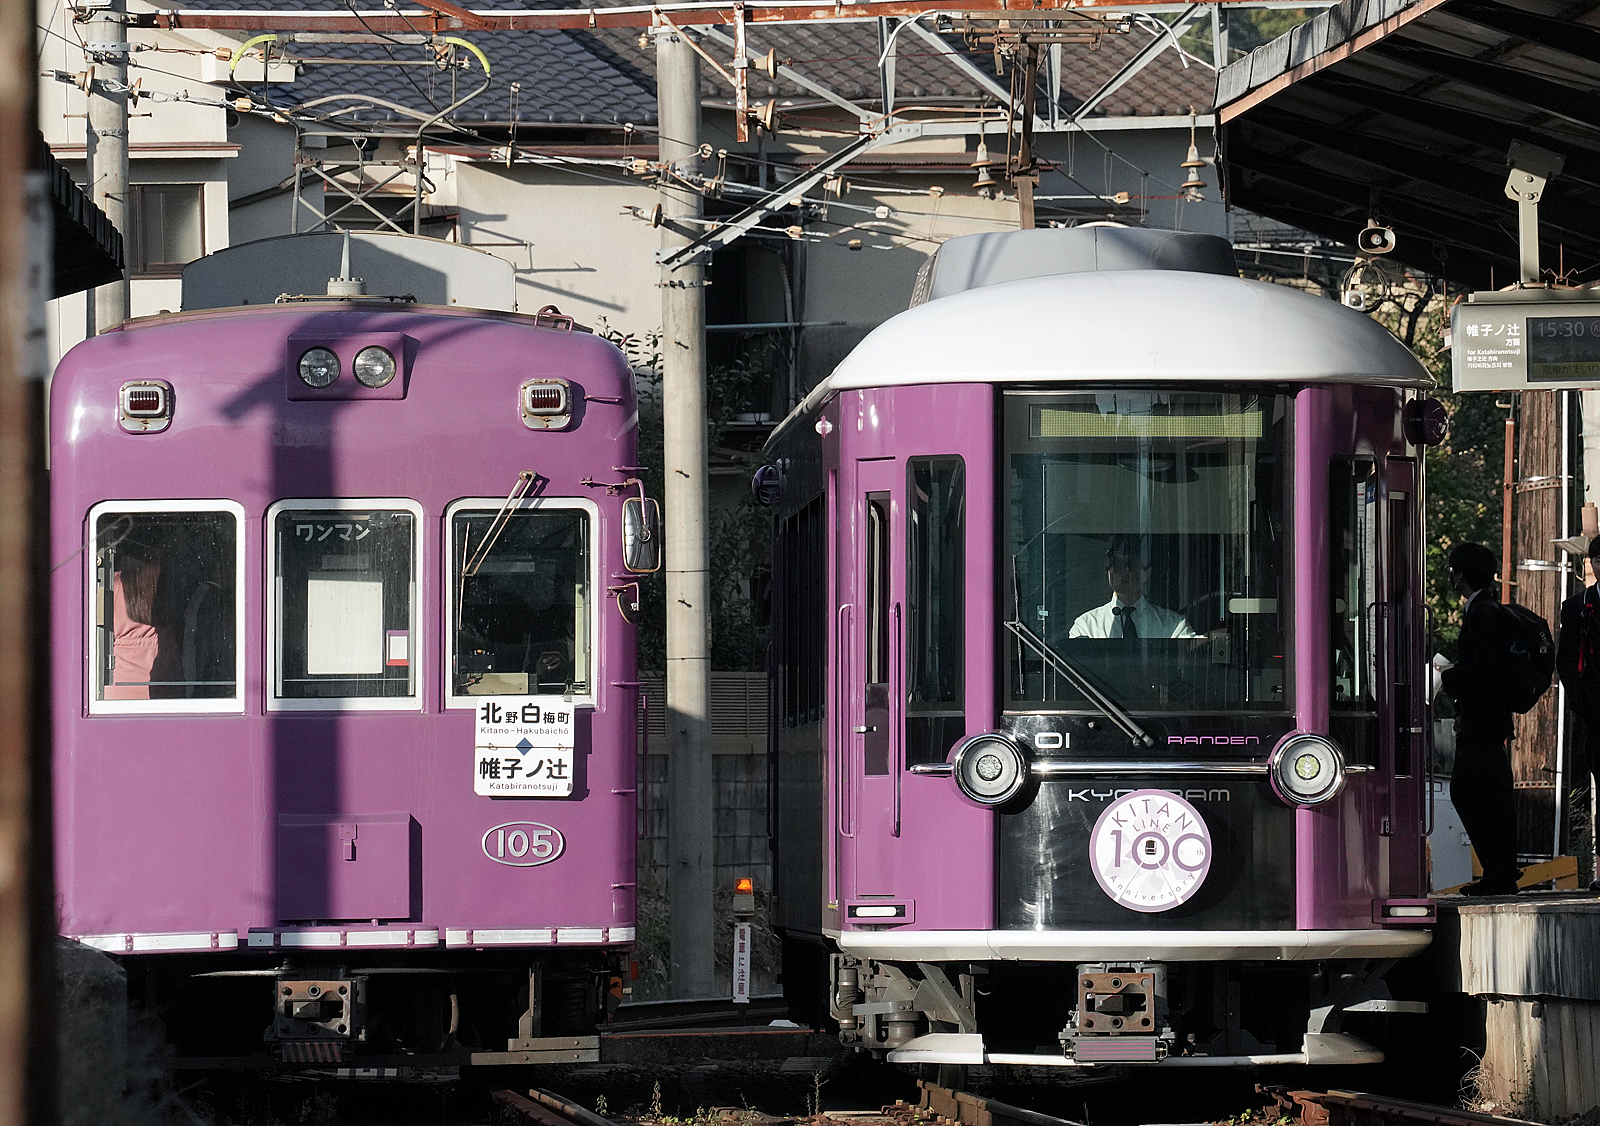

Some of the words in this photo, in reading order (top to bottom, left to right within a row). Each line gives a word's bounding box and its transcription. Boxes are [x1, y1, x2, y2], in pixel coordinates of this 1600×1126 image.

[1466, 323, 1520, 337] 帷子ノ辻
[1538, 321, 1585, 338] 15:30
[1505, 338, 1520, 346] 方面
[1477, 348, 1521, 356] Katabiranotsuji
[296, 524, 370, 542] ワンマン
[480, 702, 570, 725] 北野白梅町
[1167, 736, 1260, 745] RANDEN
[479, 757, 568, 780] 帷子ノ辻
[489, 783, 558, 791] Katabiranotsuji
[1132, 819, 1171, 834] LINE
[498, 829, 553, 858] 105
[1109, 872, 1196, 901] Anniversary
